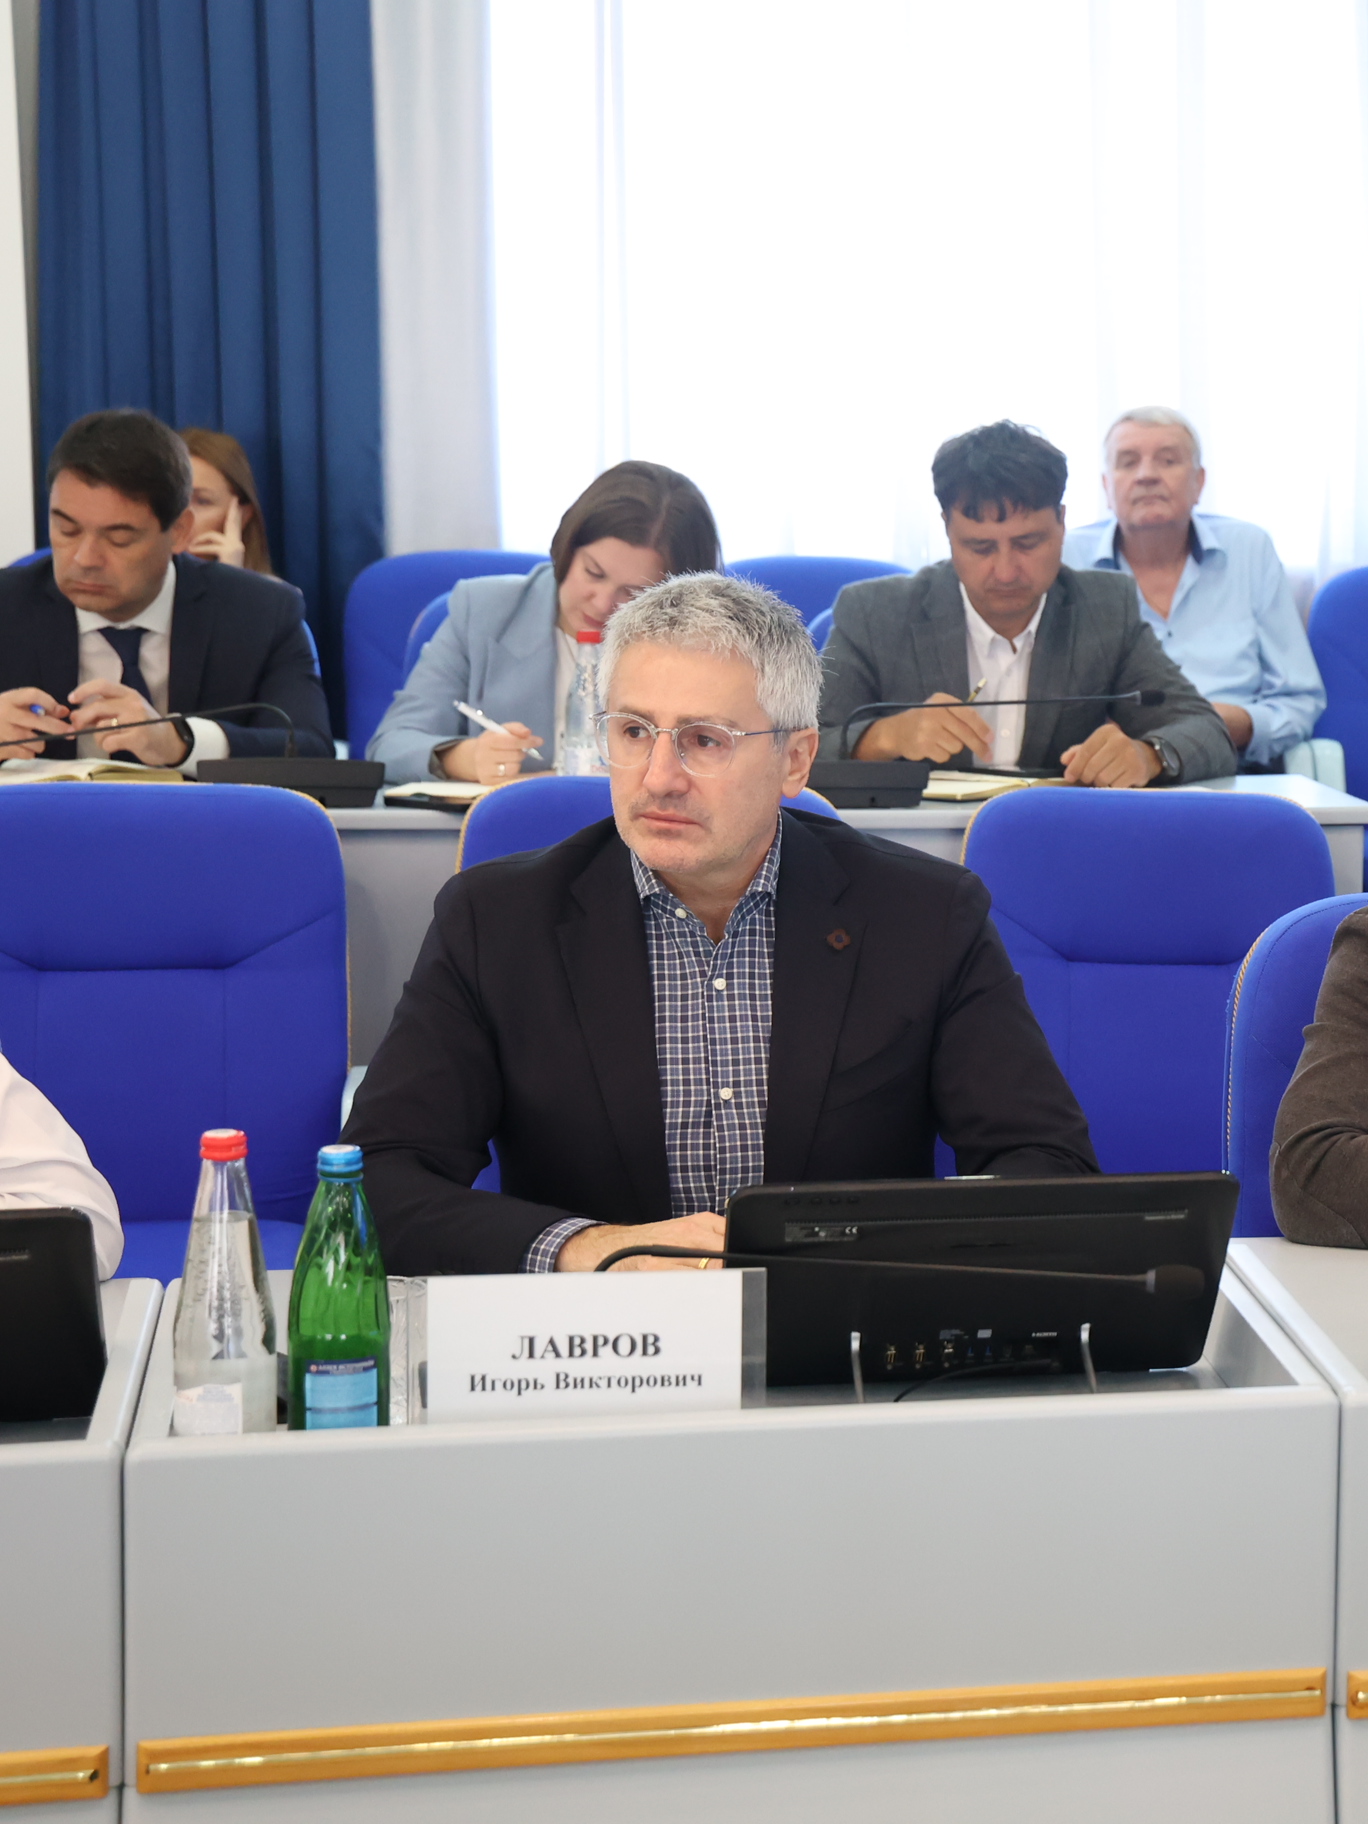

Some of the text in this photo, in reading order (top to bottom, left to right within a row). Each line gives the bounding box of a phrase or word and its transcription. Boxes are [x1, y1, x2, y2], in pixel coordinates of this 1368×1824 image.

[511, 1332, 662, 1360] ЛАВРОВ
[469, 1371, 703, 1396] Игорь Викторович
